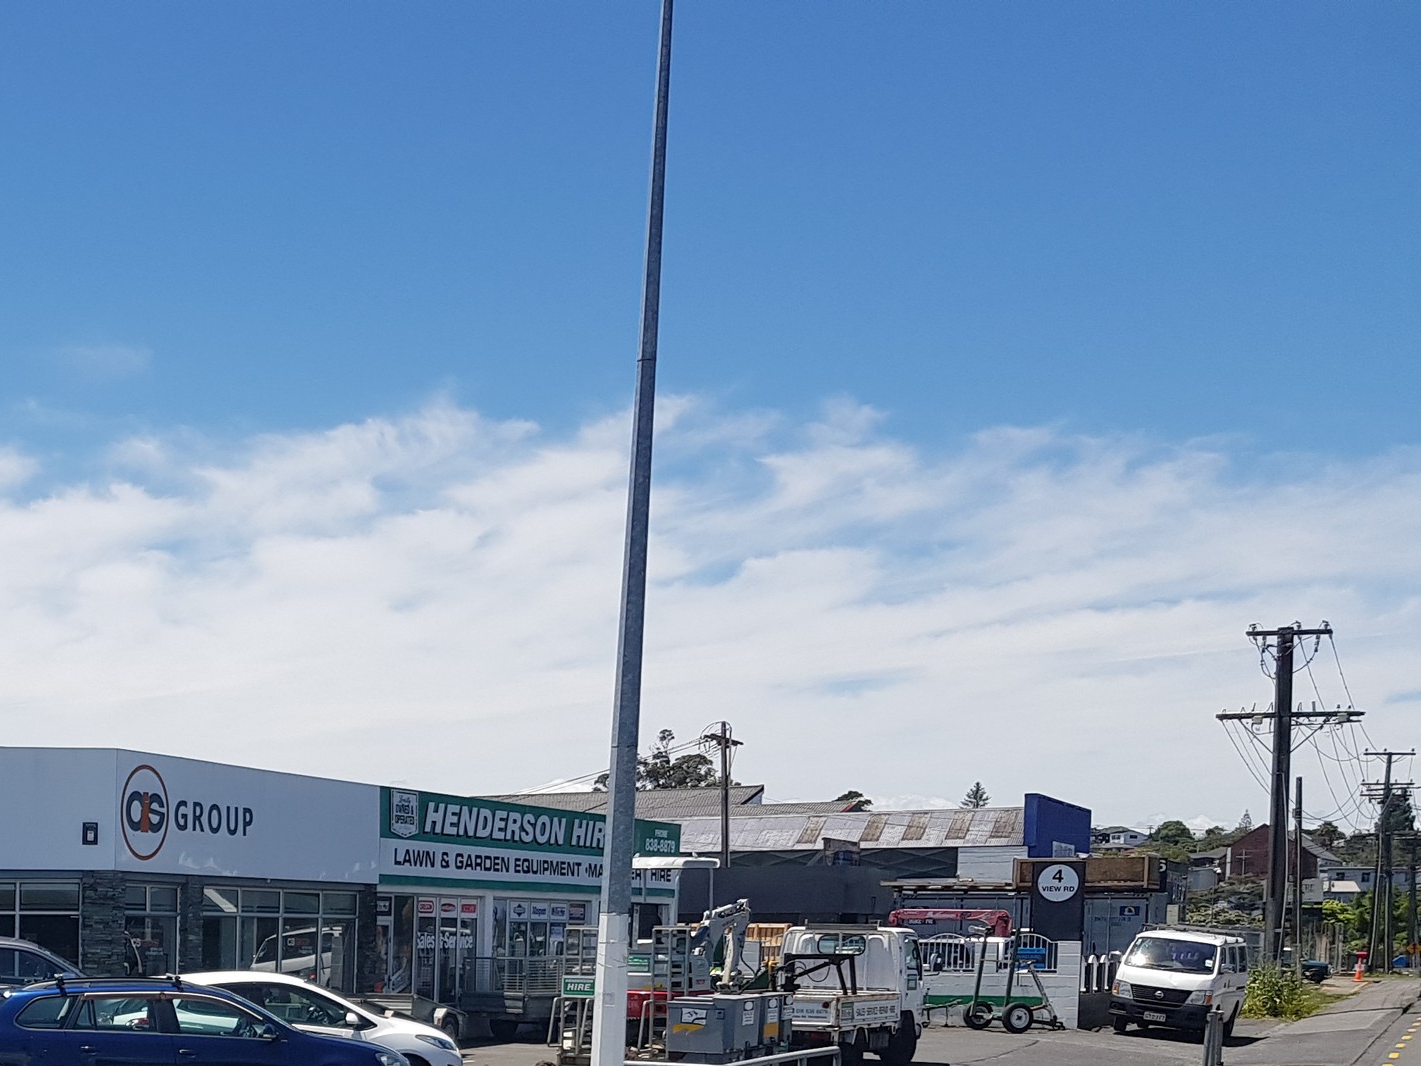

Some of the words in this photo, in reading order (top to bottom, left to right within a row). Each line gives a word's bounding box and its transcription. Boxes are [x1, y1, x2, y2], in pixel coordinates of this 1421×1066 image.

[174, 800, 254, 837] GROUP
[423, 801, 567, 846] HENDERSON
[570, 819, 606, 849] HIR
[393, 847, 436, 868] LAWN
[440, 851, 450, 869] &
[454, 853, 511, 873] GARDEN
[513, 857, 582, 877] EQUIPMENT
[650, 869, 672, 882] HIRE
[1052, 868, 1064, 883] 4
[566, 983, 591, 991] HIRE
